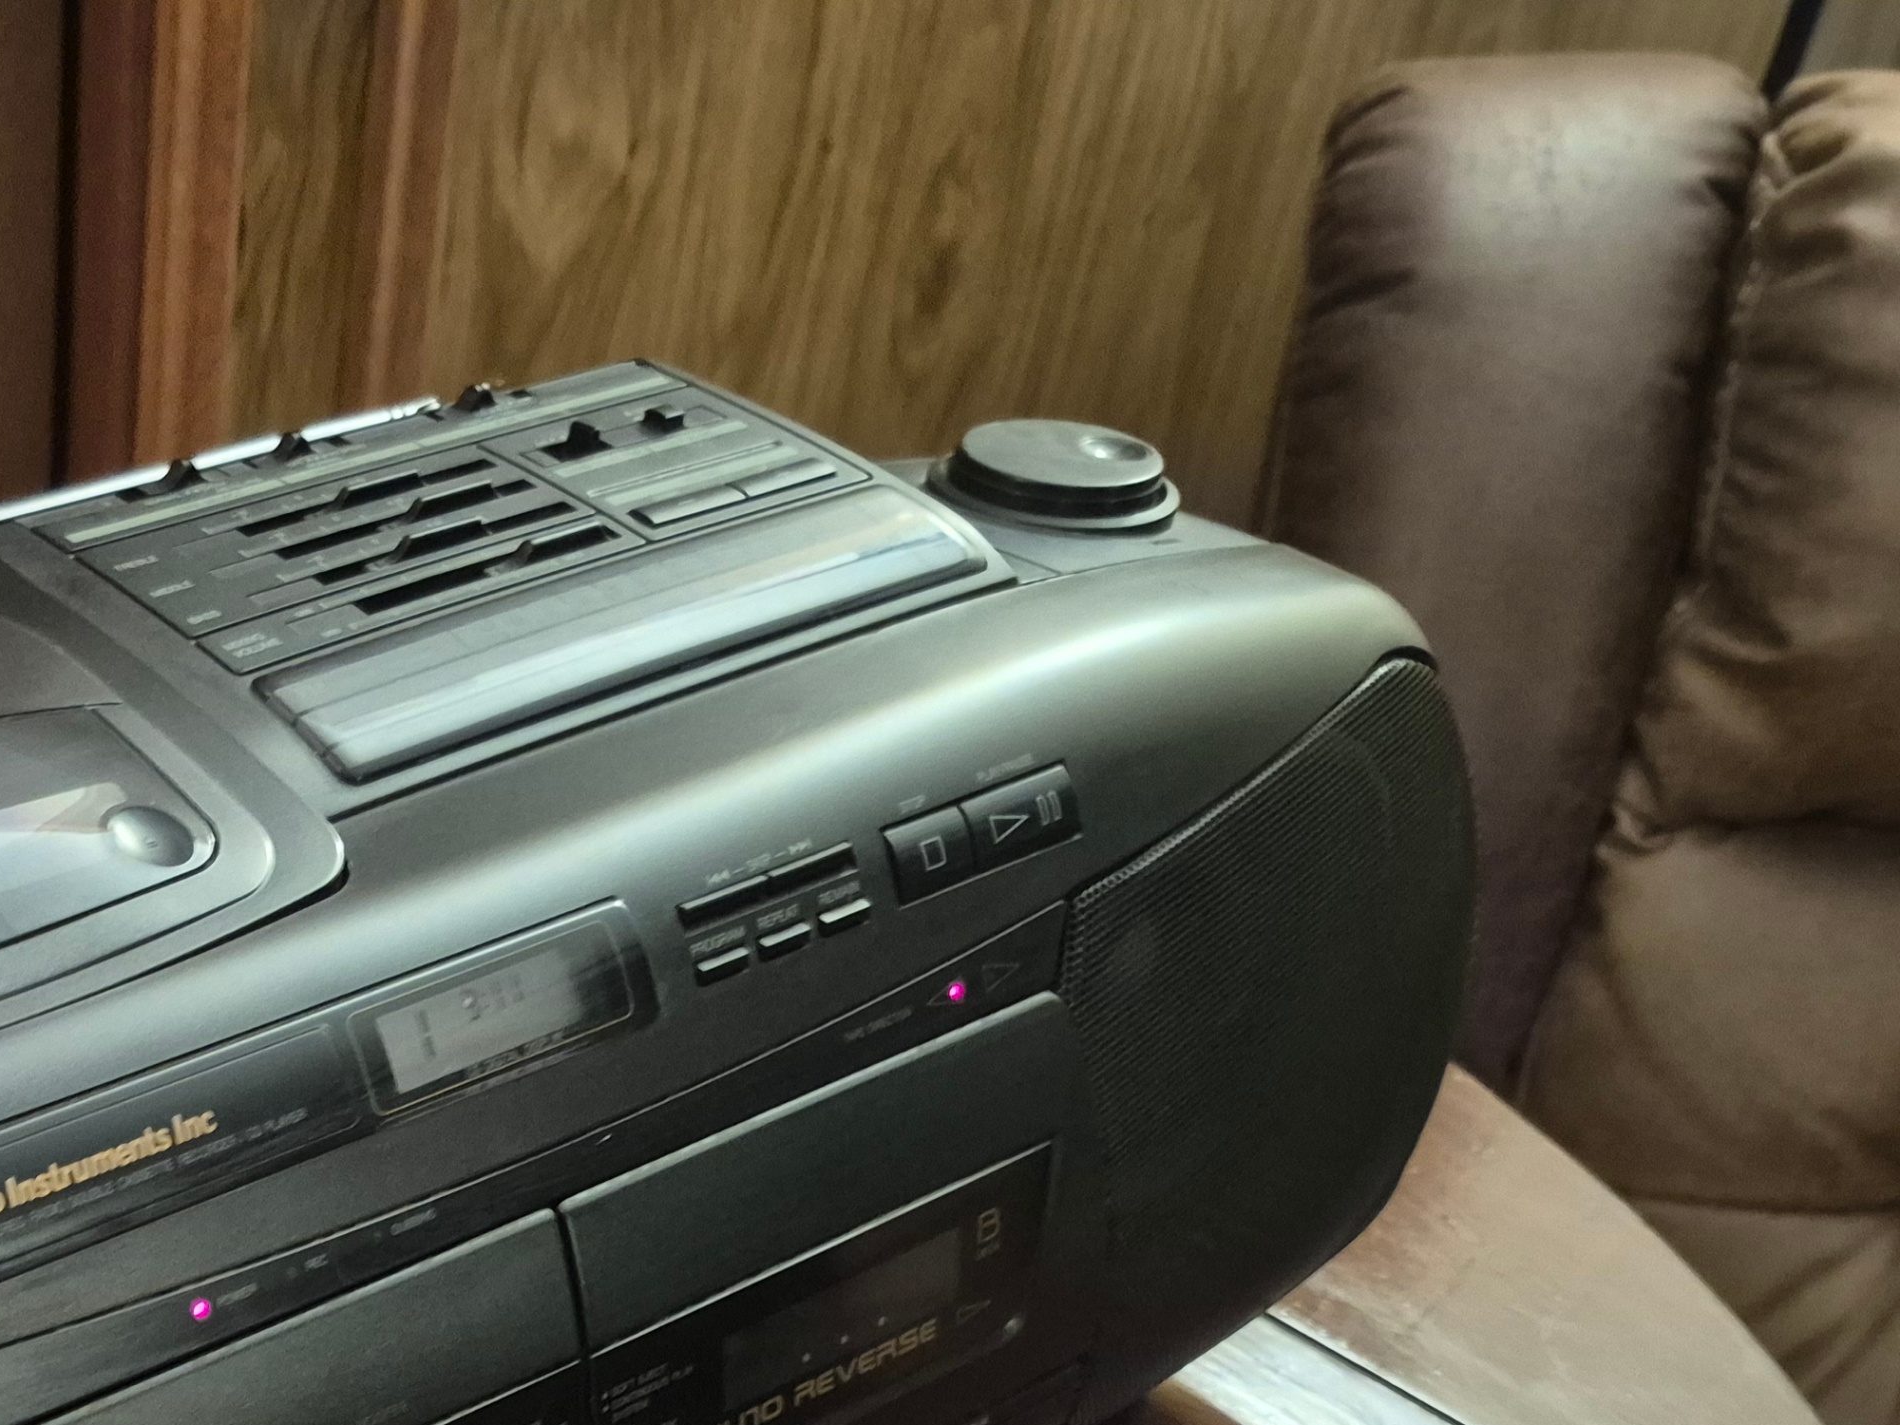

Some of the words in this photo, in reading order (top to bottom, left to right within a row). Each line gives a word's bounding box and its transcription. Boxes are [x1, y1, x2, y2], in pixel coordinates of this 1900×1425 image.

[5, 1126, 172, 1208] Instruments
[172, 1110, 219, 1146] Inc
[793, 1317, 938, 1407] REVERSE
